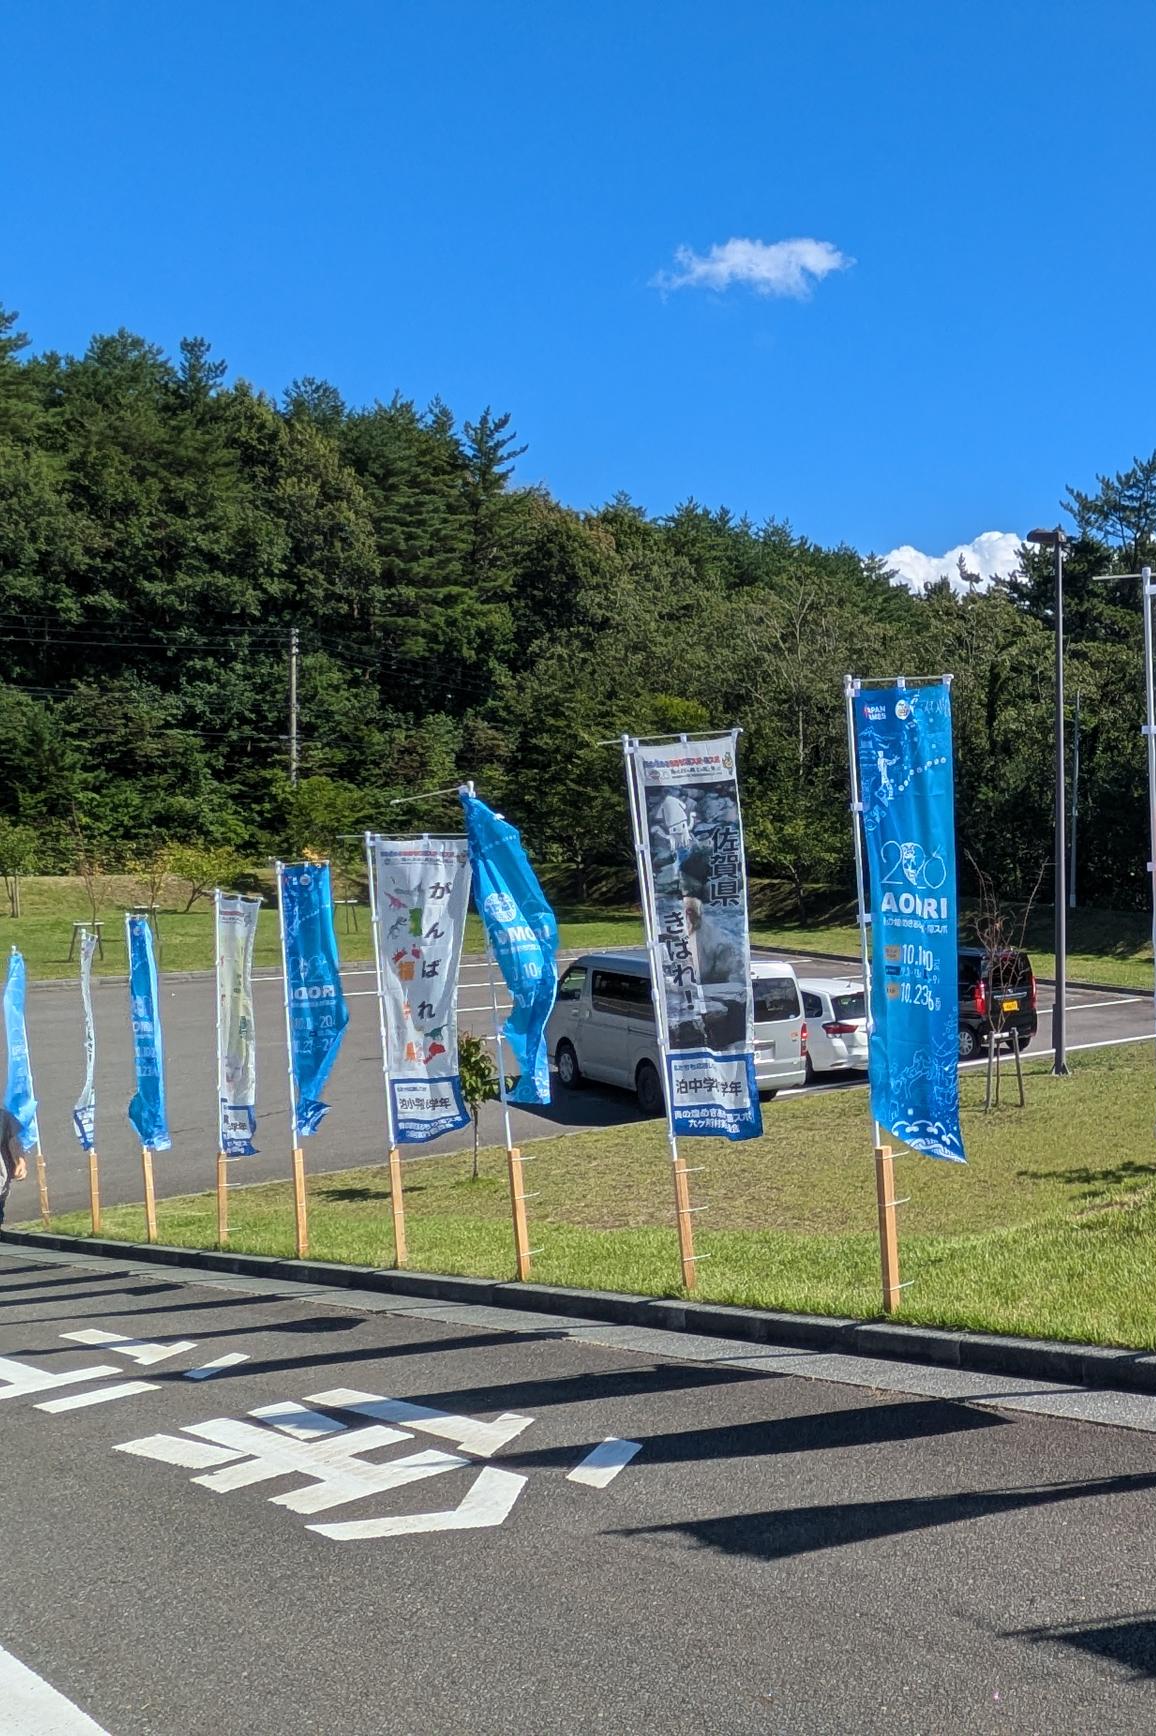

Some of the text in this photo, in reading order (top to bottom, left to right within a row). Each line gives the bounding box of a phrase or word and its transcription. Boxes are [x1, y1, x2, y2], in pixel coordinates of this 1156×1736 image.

[710, 826, 740, 907] 佐賀県
[417, 881, 452, 1020] がんばれ
